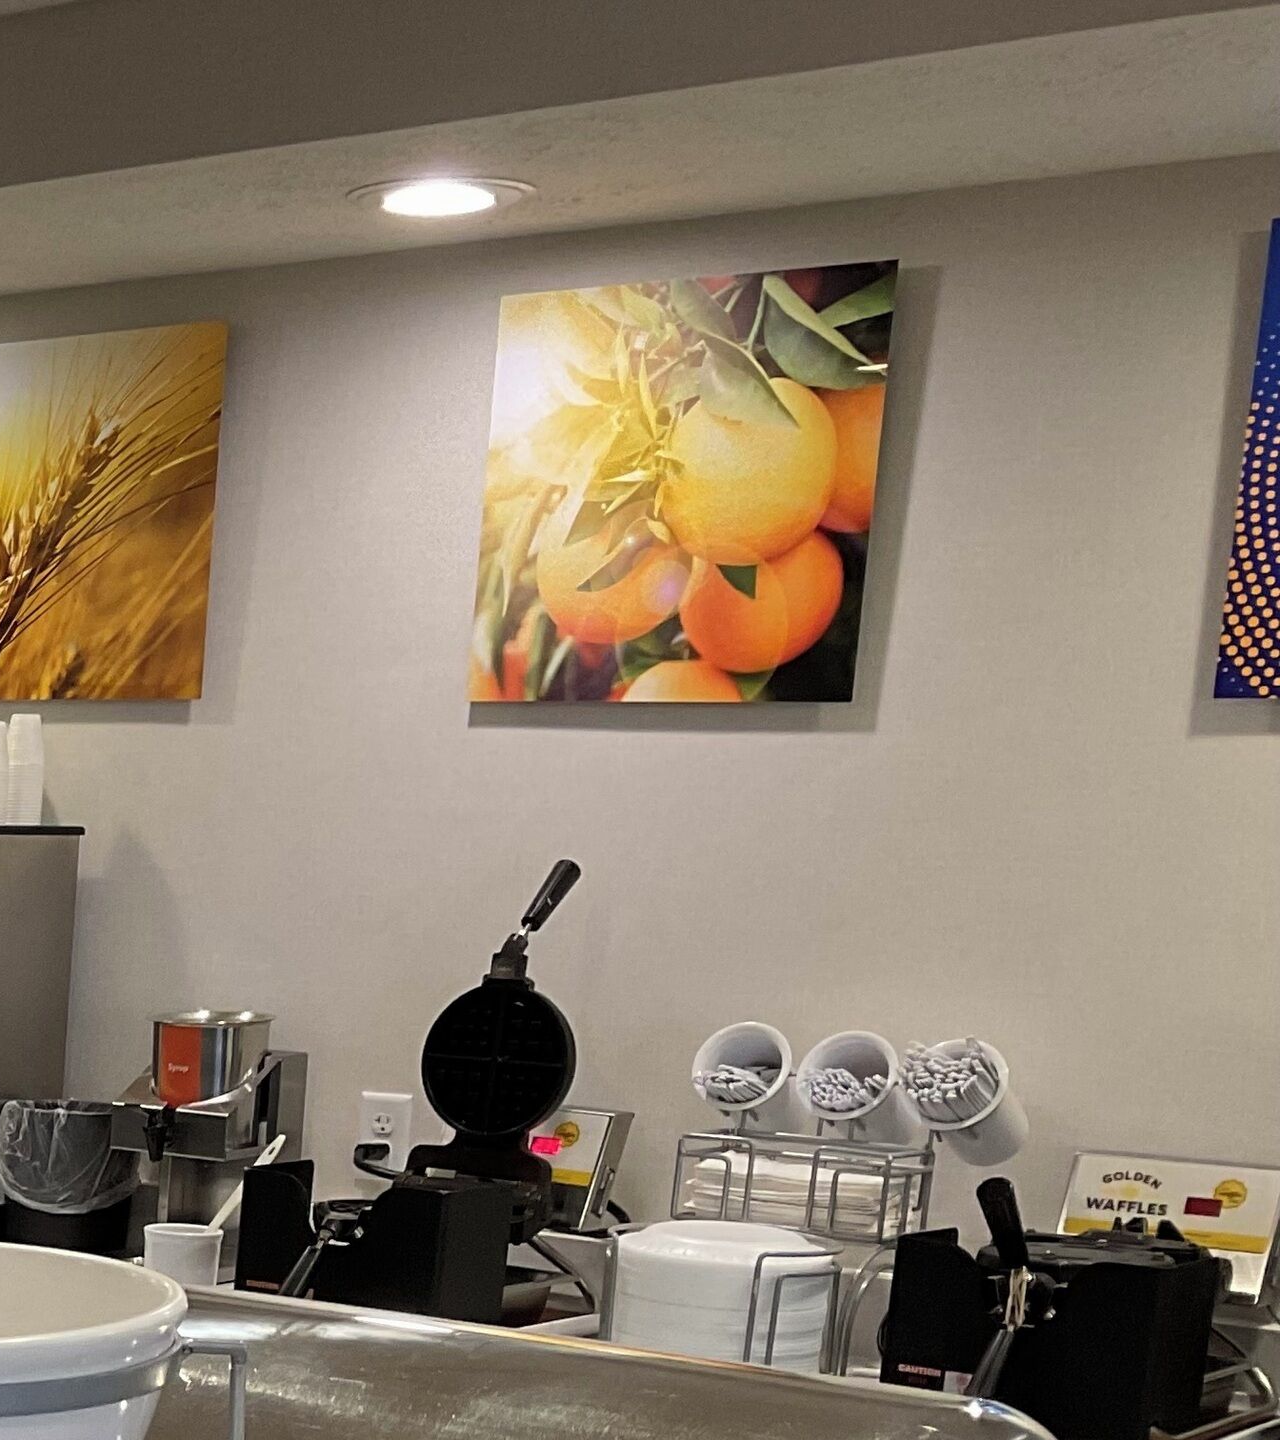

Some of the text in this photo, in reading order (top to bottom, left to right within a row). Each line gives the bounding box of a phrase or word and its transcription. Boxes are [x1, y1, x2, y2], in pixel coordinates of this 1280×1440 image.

[1102, 1170, 1162, 1190] GOLDEN
[1086, 1196, 1169, 1216] WAFFLES
[897, 1363, 941, 1377] CAUTION
